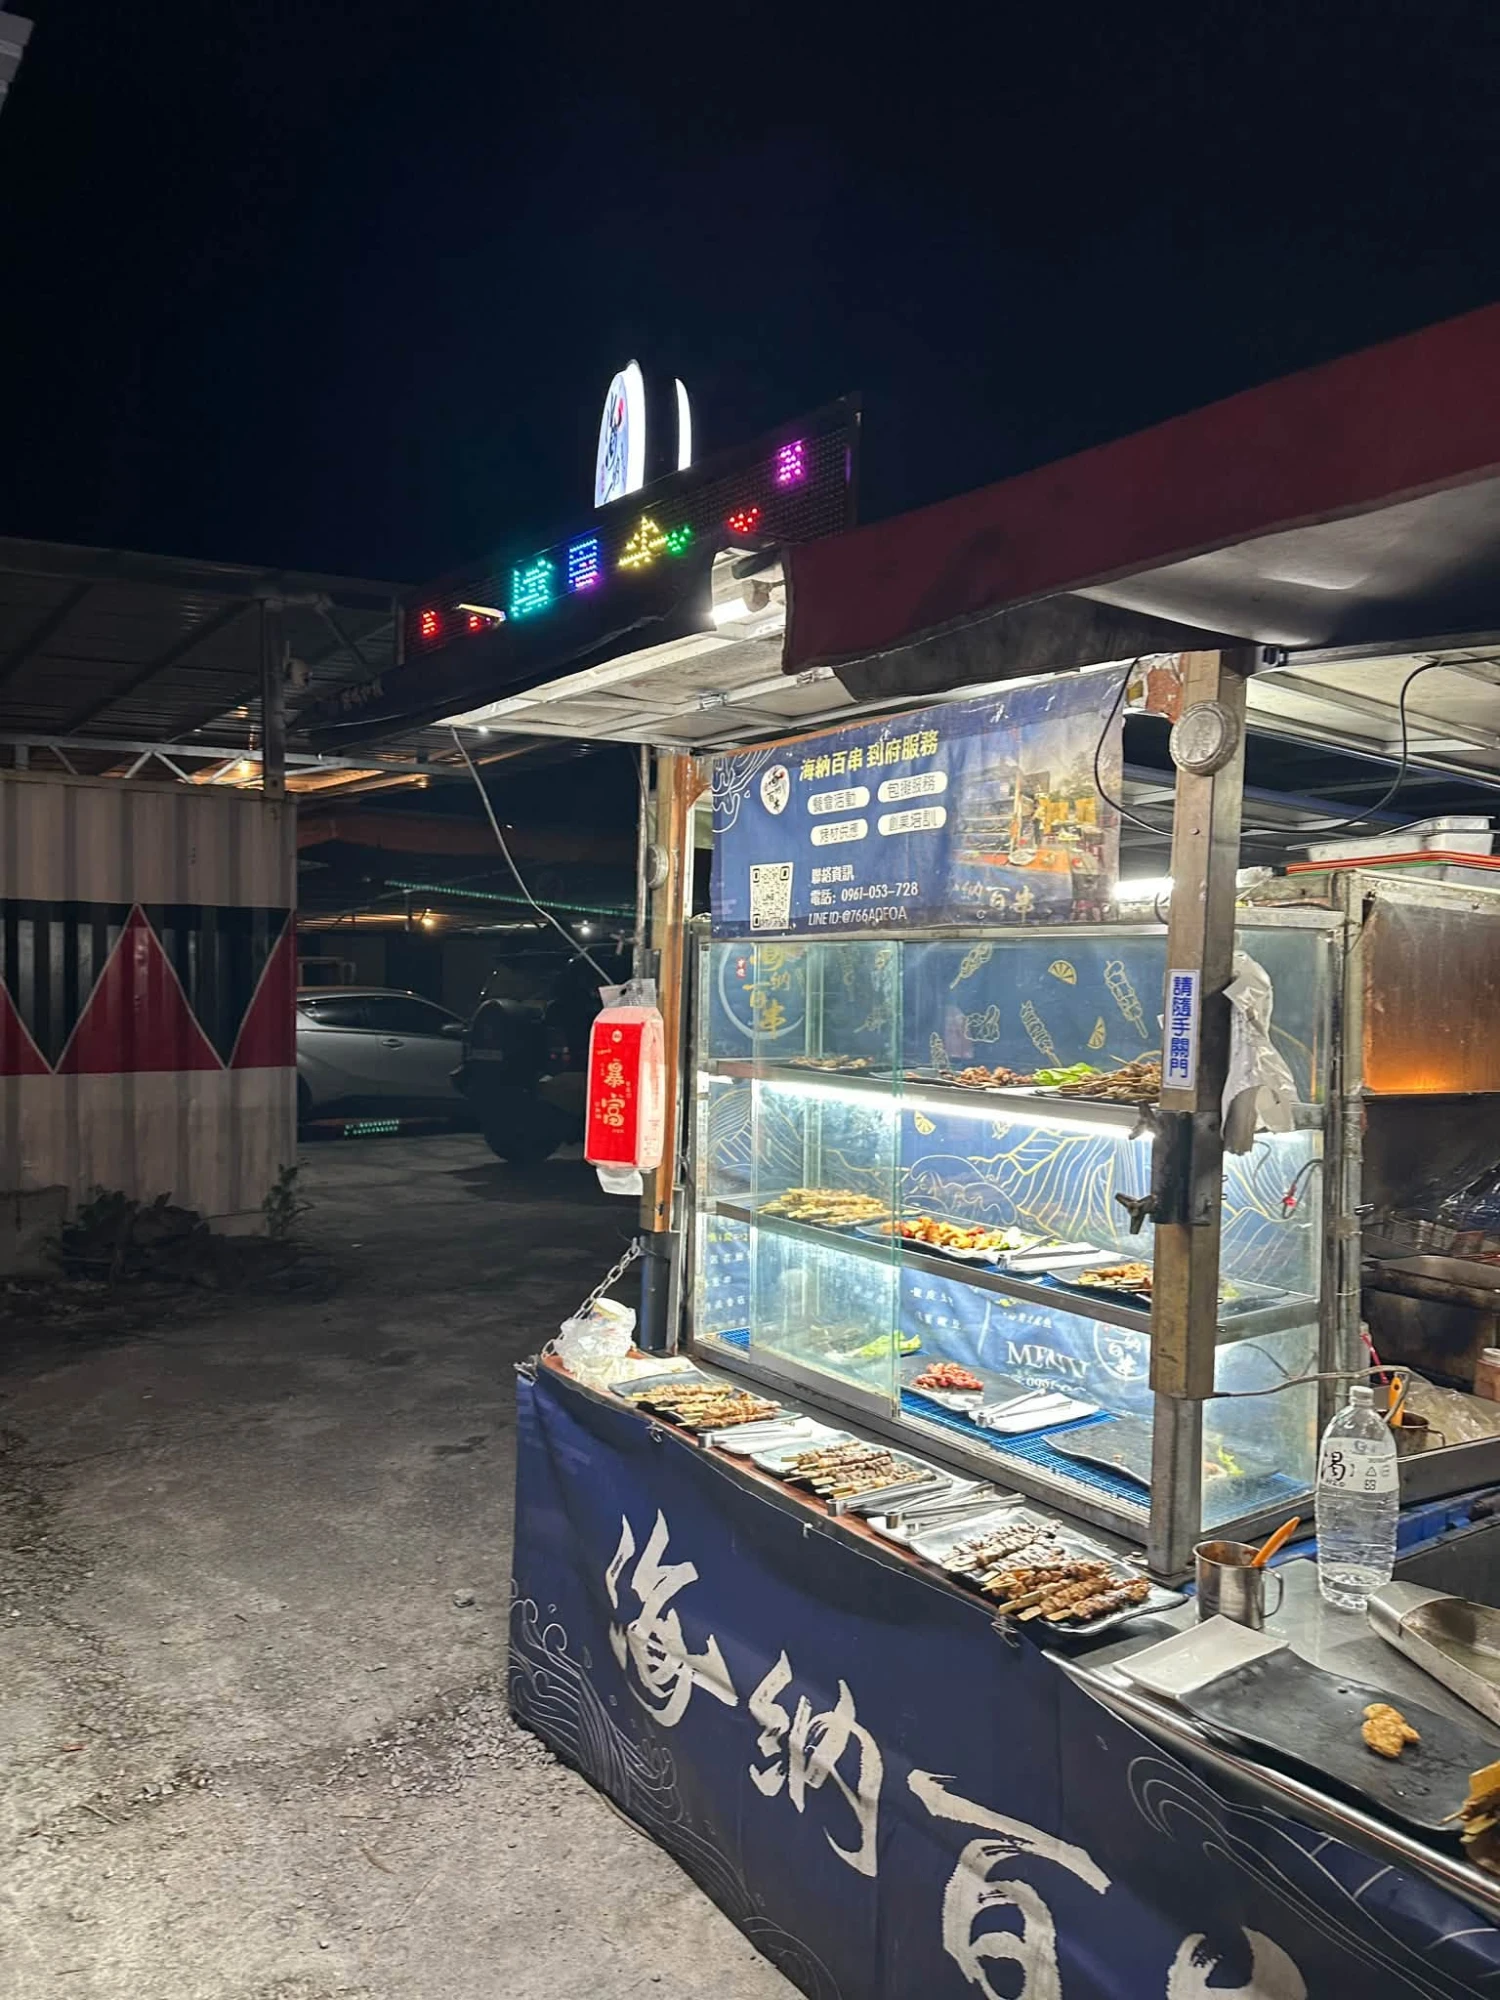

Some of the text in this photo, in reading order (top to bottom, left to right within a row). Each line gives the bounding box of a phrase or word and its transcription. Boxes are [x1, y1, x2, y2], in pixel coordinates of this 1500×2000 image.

[799, 729, 939, 782] 海納百串 到府服務
[841, 882, 919, 902] 0961-053-728
[808, 911, 828, 926] LINE
[1169, 976, 1193, 1078] 請隨手關門
[1006, 1341, 1091, 1379] MENU
